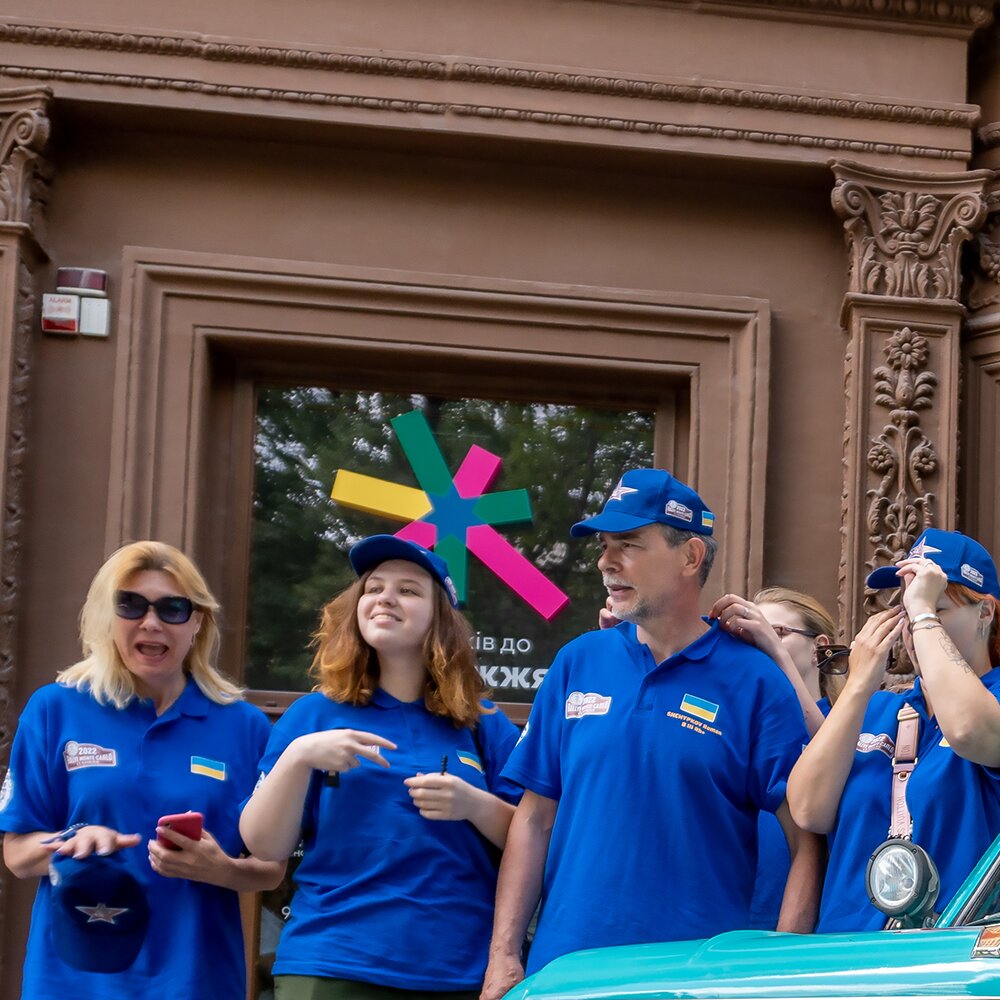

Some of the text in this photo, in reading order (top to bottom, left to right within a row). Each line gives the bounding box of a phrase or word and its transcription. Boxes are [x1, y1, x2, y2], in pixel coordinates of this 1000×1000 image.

[500, 638, 531, 655] до
[78, 747, 97, 755] 2022
[95, 752, 113, 761] CARLO
